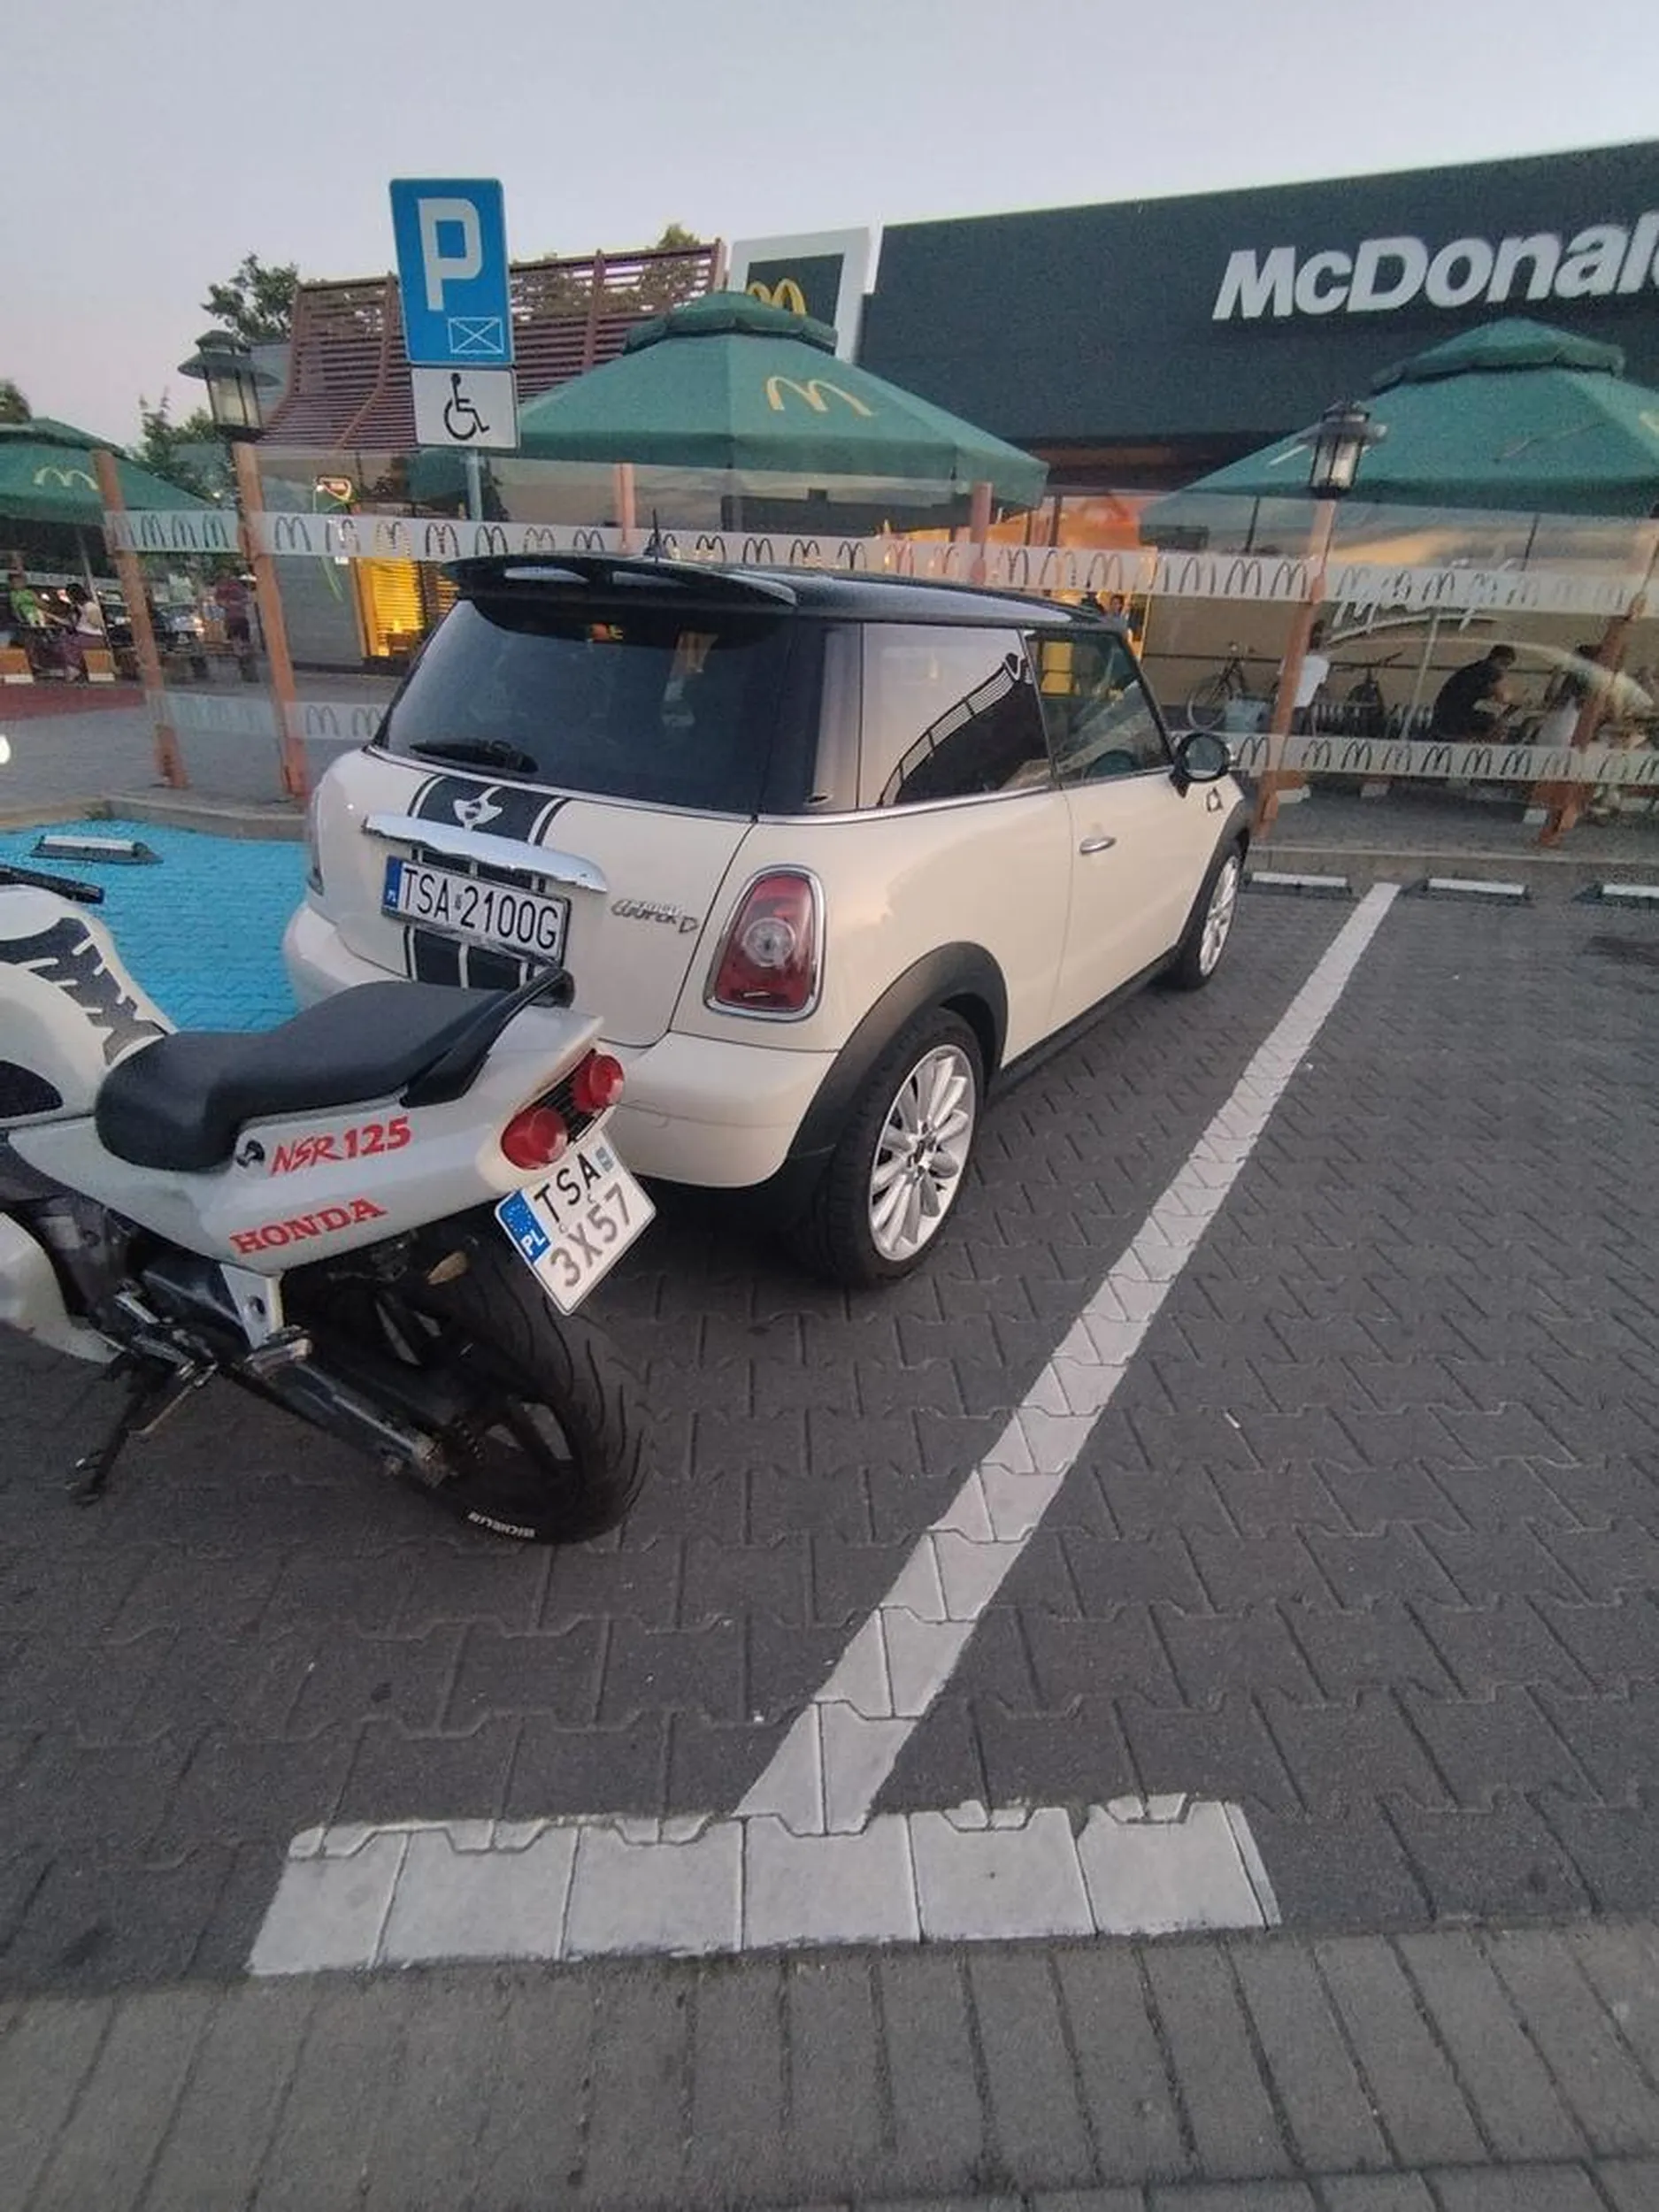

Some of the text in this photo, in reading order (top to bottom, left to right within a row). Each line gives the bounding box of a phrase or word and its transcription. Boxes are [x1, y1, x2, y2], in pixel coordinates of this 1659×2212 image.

[418, 197, 483, 311] P
[1211, 210, 1659, 320] McDonal
[404, 868, 558, 949] TSA 2100G
[271, 1117, 411, 1176] NSR 125
[534, 1153, 602, 1223] TSA
[229, 1198, 388, 1254] HONDA
[520, 1229, 547, 1256] PL
[550, 1182, 630, 1286] 3X57
